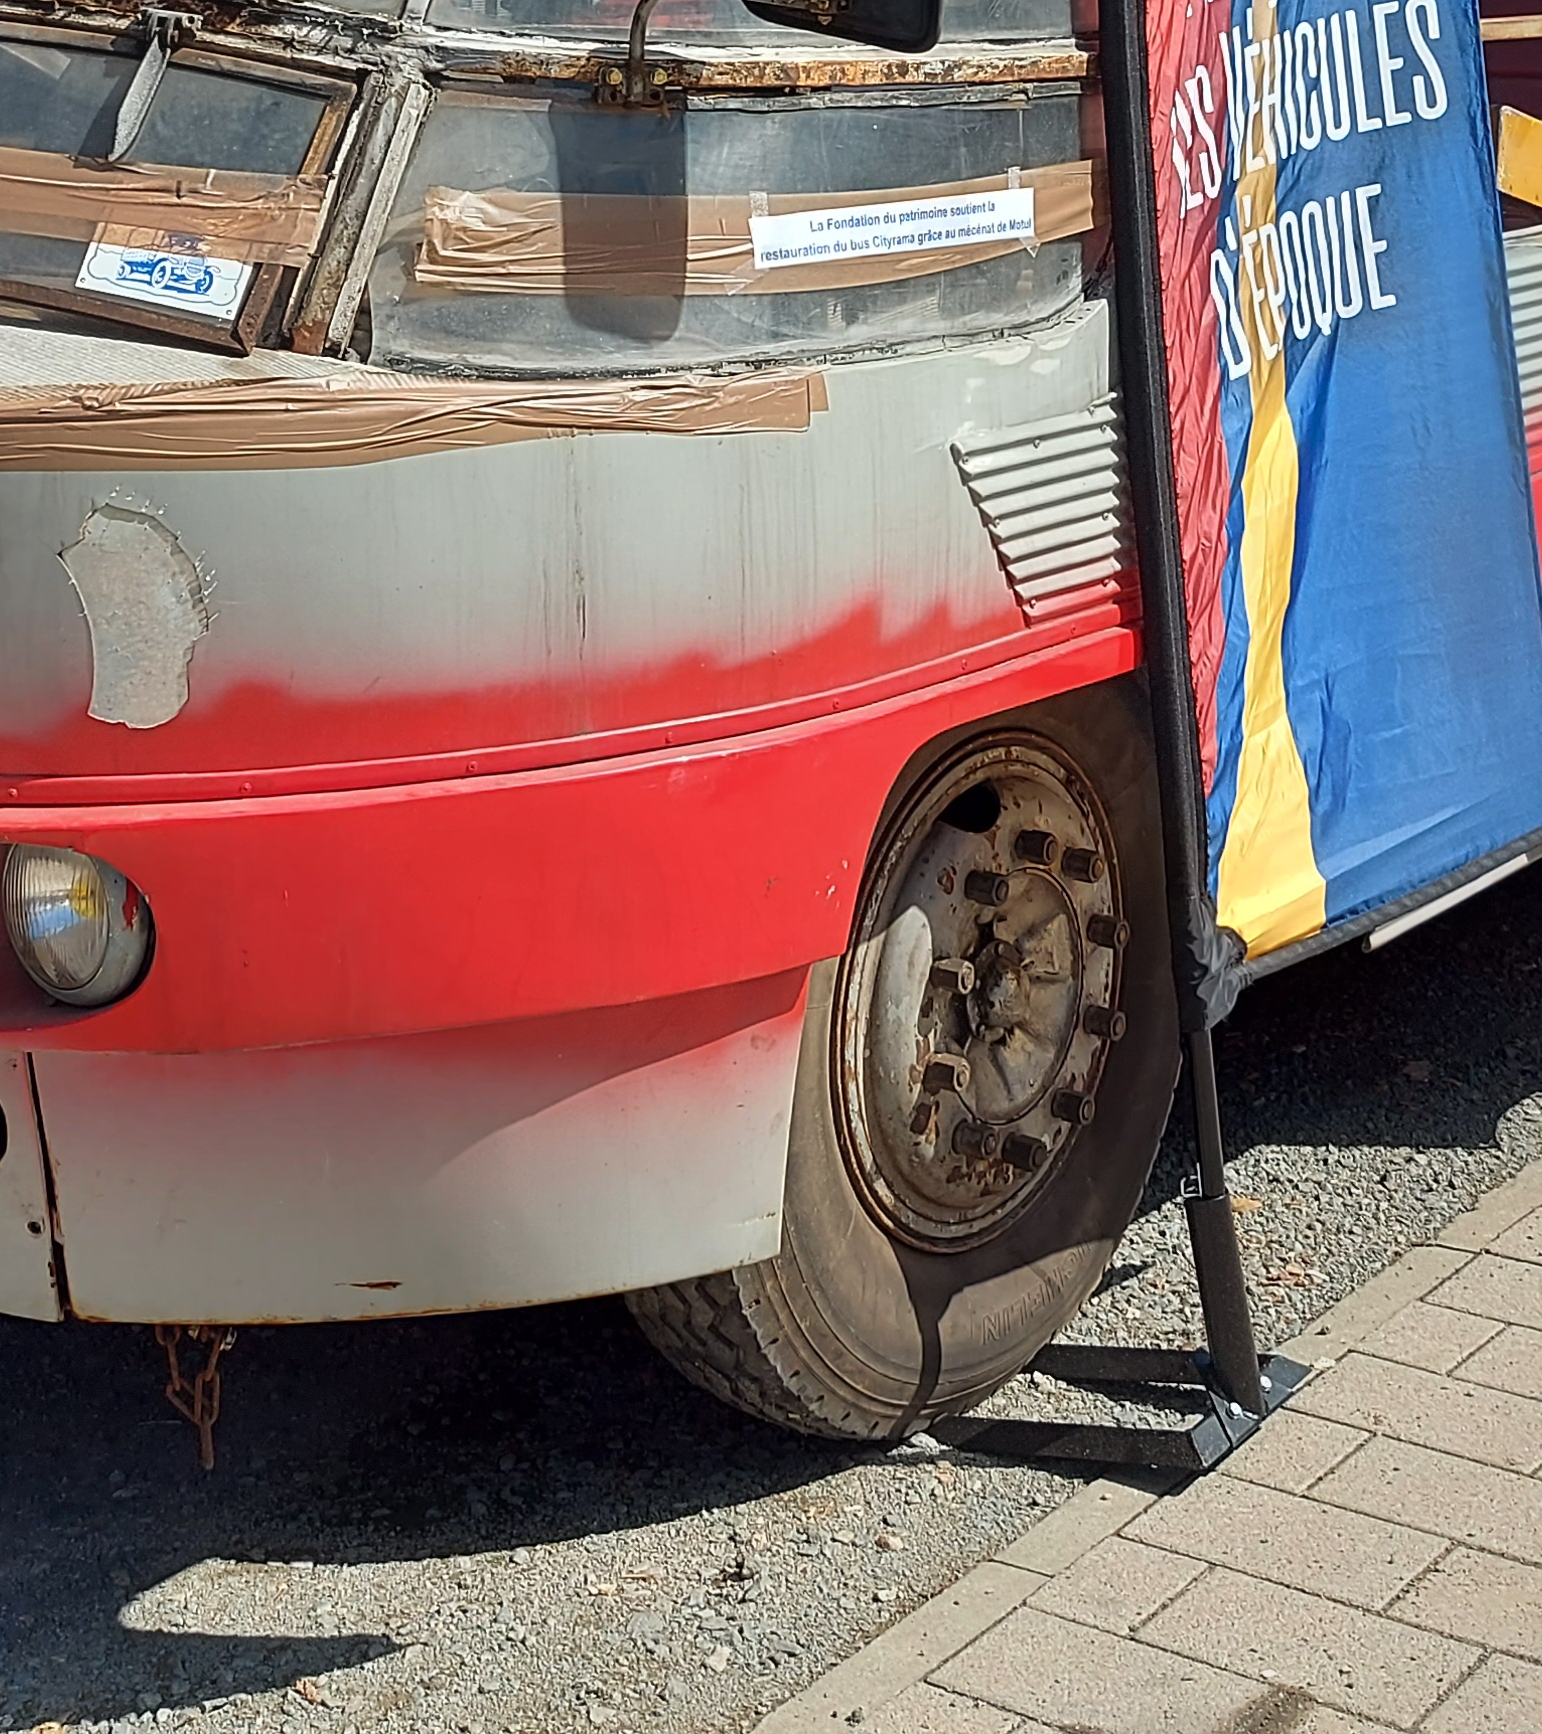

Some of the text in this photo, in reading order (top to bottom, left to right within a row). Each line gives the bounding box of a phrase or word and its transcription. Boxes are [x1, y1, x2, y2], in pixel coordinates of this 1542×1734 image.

[809, 200, 996, 233] La Fondation du patrimoine soutient la
[760, 217, 1032, 263] restauration du bus Cityrama grâce au mécénat de Motul
[1209, 183, 1398, 381] D'ÉPOQUE
